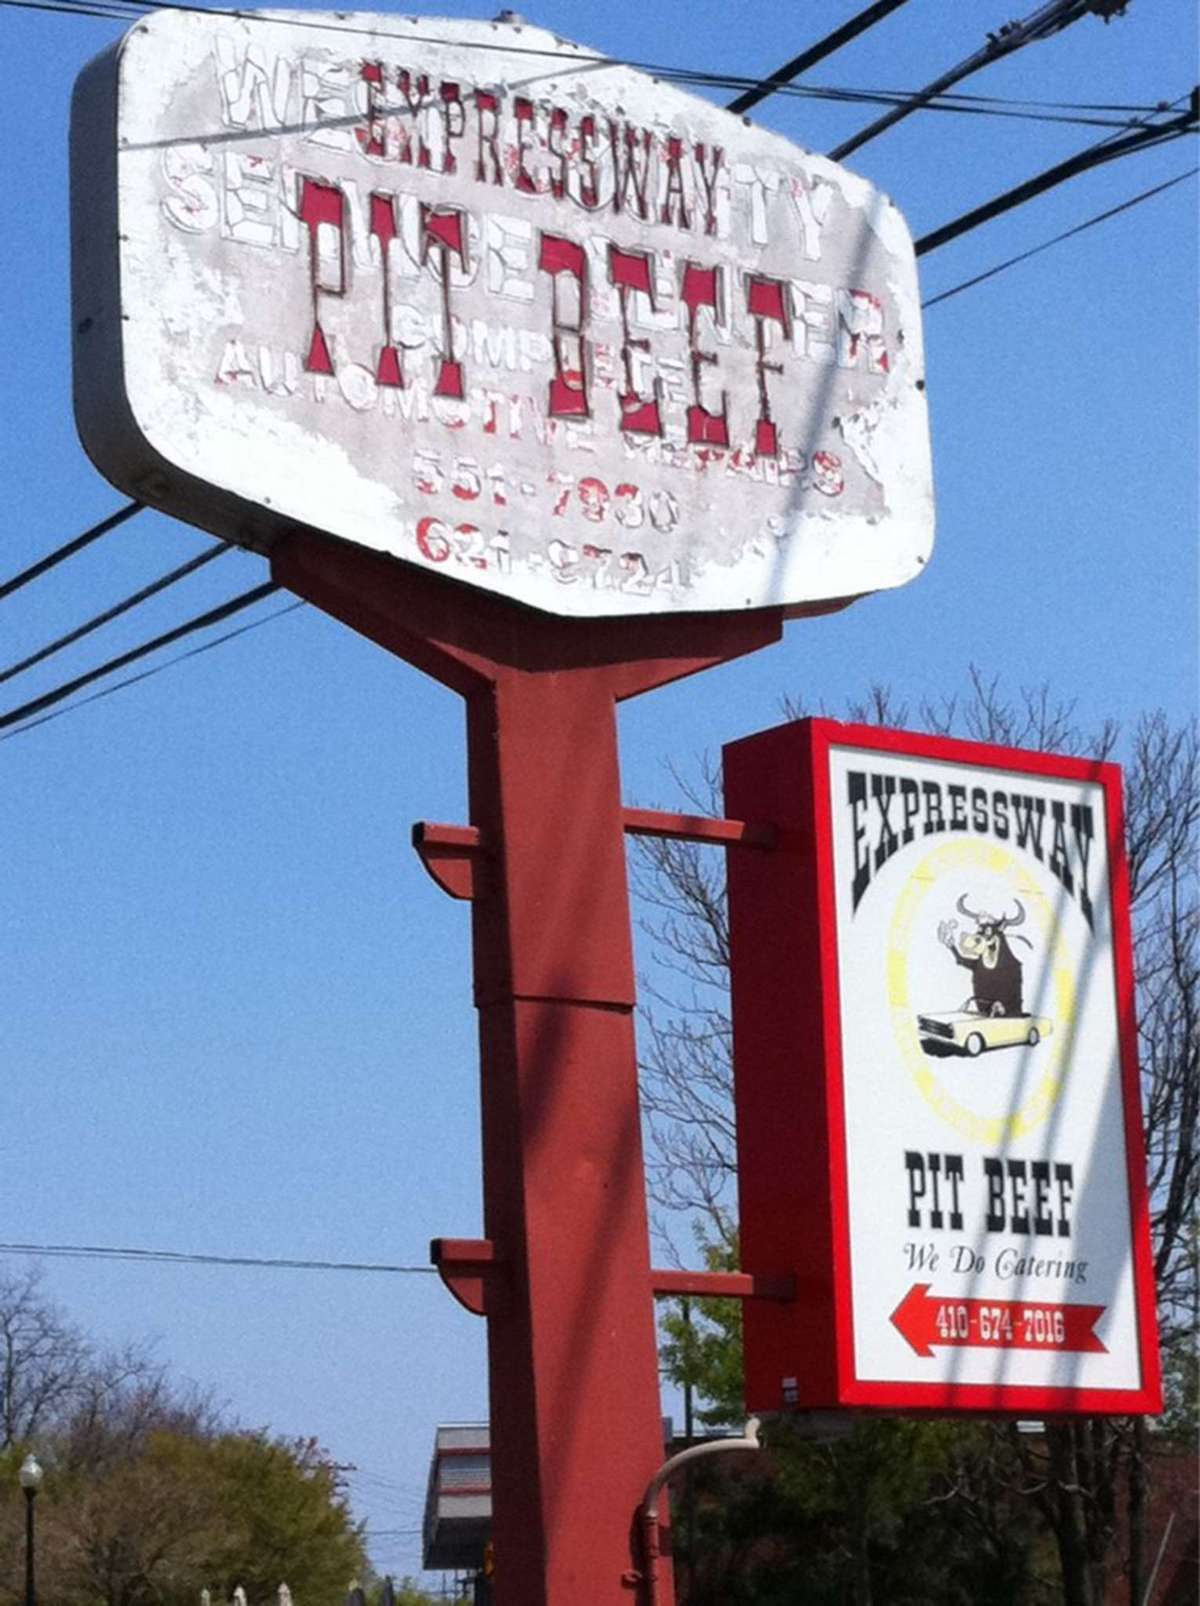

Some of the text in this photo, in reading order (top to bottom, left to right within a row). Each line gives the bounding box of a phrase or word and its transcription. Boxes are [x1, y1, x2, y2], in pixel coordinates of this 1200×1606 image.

[358, 58, 726, 236] EXPRESSWAY
[299, 172, 793, 457] PIT BEEF
[846, 770, 1095, 936] EXPRESSWAY
[904, 1150, 1075, 1238] PIT BEEF
[903, 1243, 1089, 1284] We Do Catering
[935, 1304, 1067, 1344] 410-674-7016
